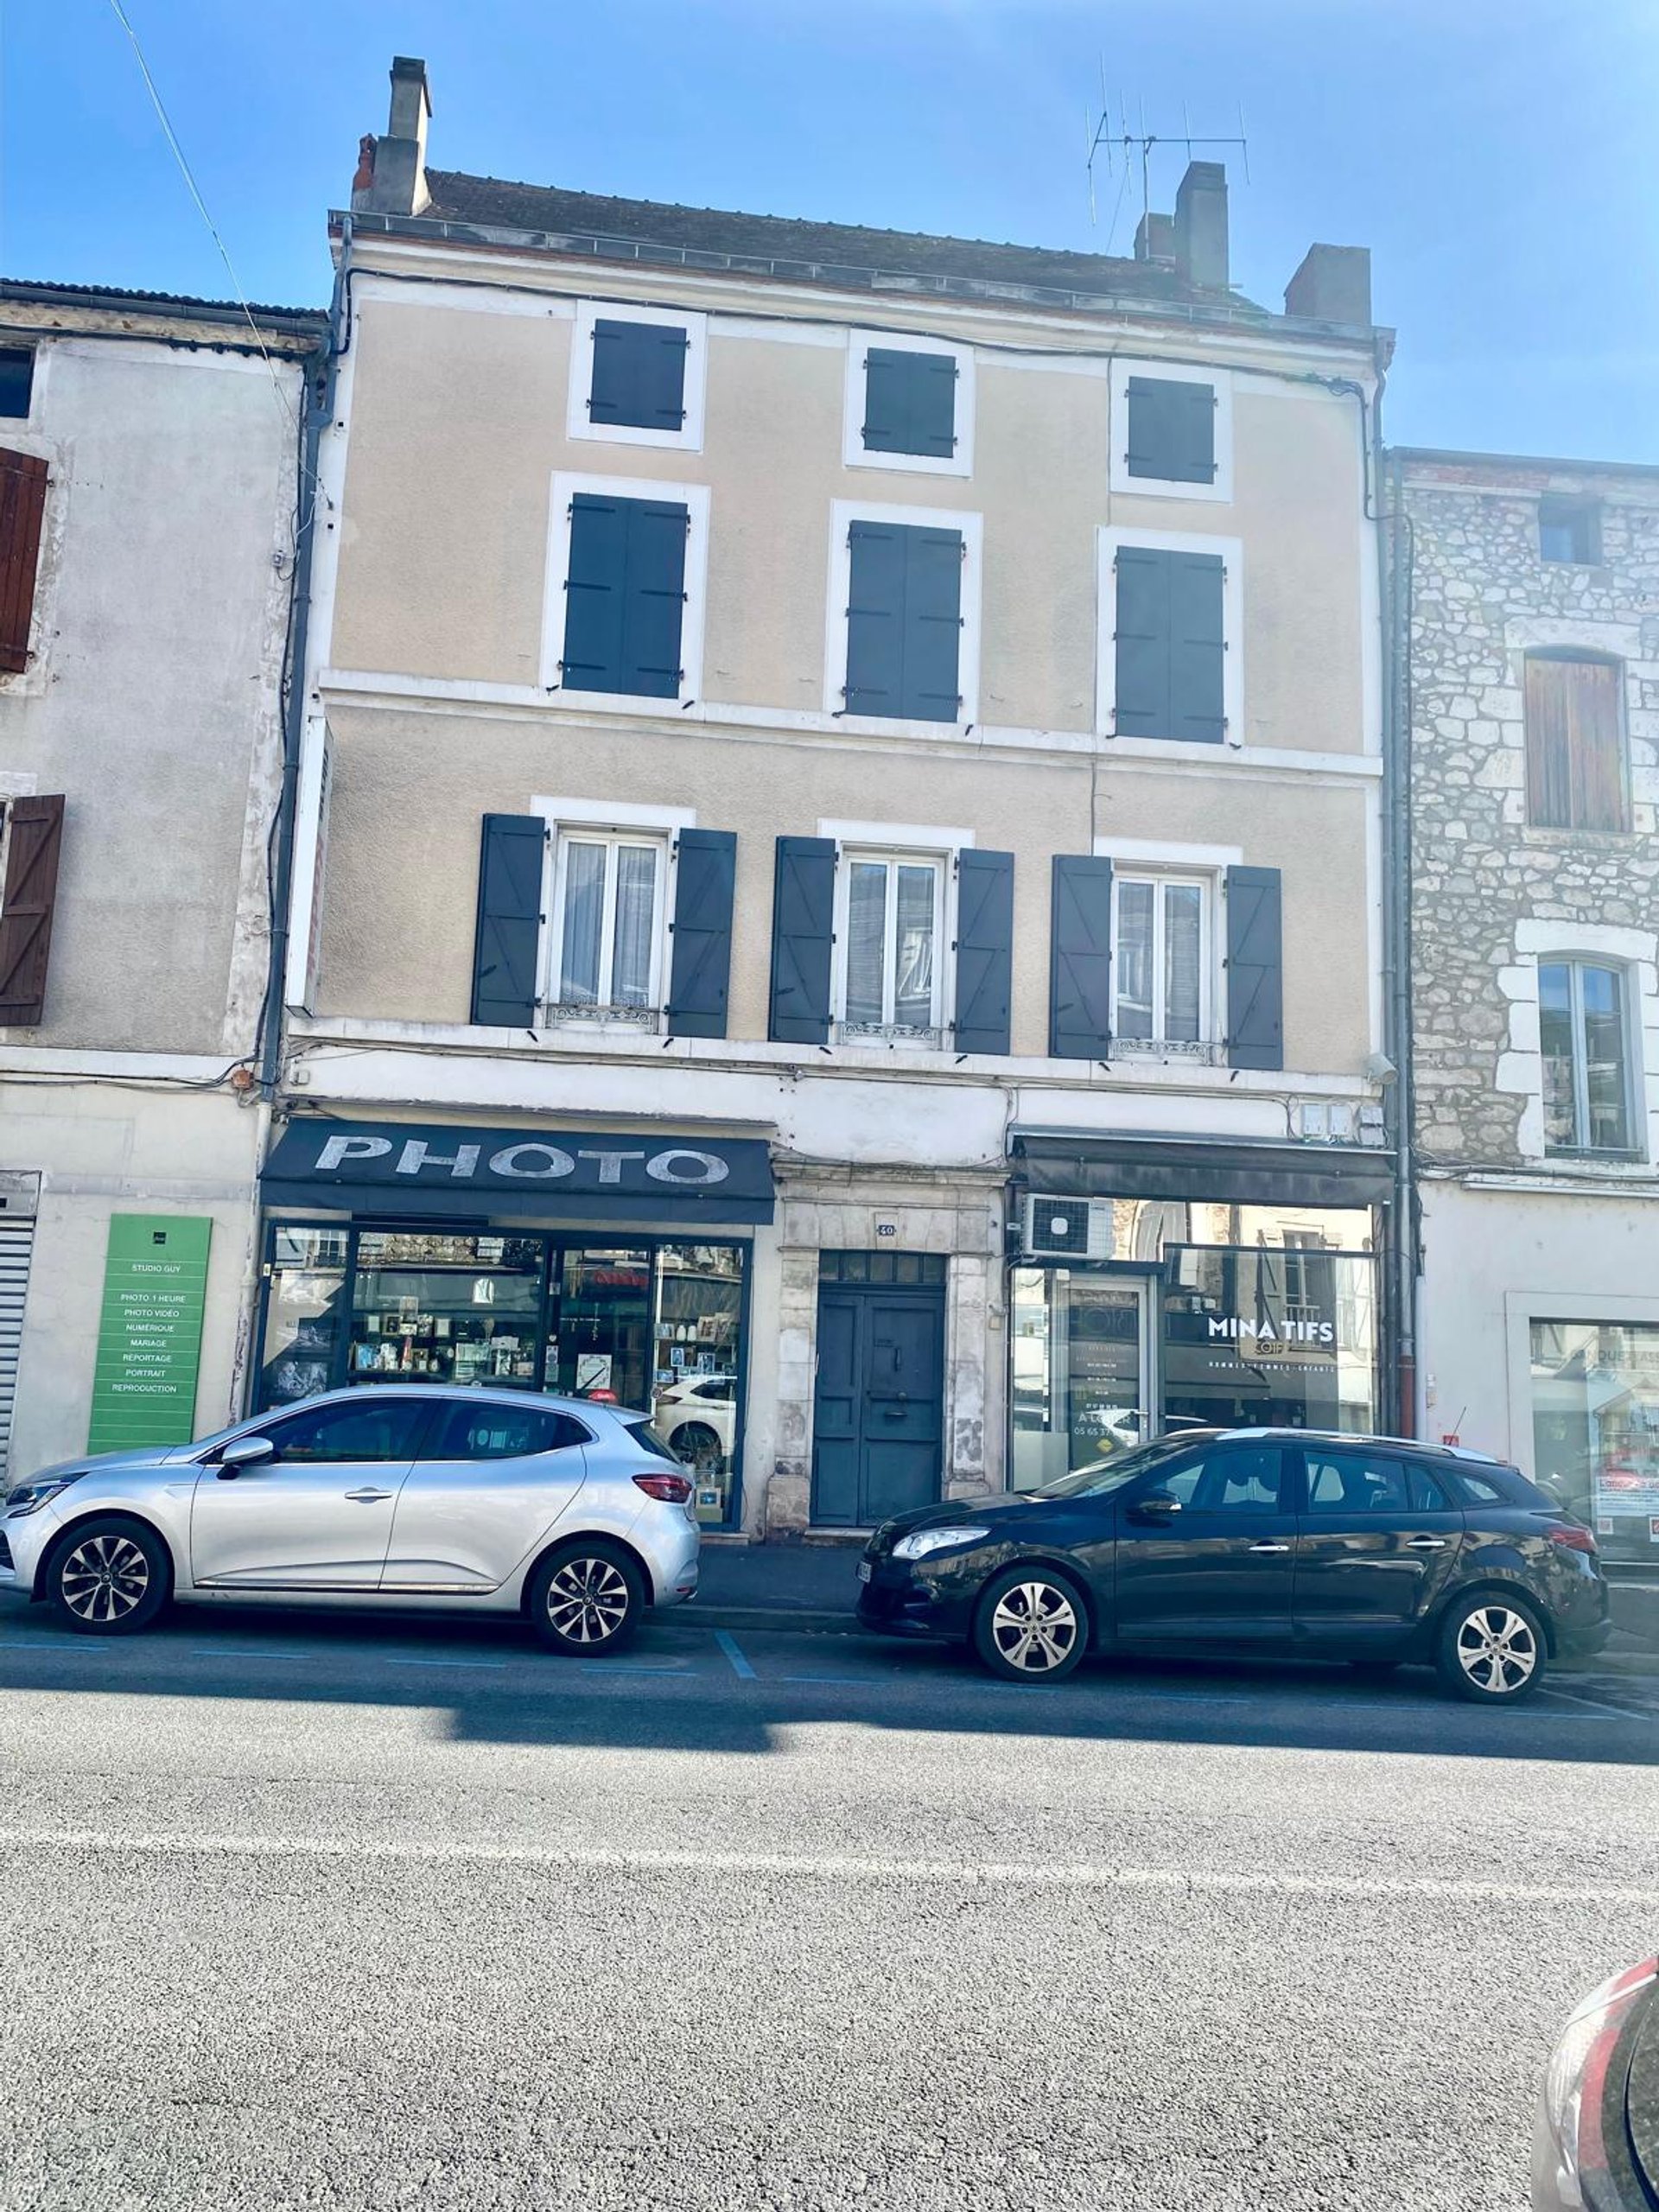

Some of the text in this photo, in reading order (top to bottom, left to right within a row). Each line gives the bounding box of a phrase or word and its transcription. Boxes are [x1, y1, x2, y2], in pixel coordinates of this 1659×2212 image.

[315, 1135, 729, 1185] PHOTO
[120, 1294, 149, 1302] PHOTO
[159, 1294, 187, 1303] HEURE
[1208, 1318, 1334, 1342] MINA TIFS
[123, 1354, 173, 1363] REPORTAGE
[125, 1369, 166, 1377] PORTRAIT
[112, 1384, 177, 1393] REPRODUCTION
[1090, 1413, 1131, 1424] LOER
